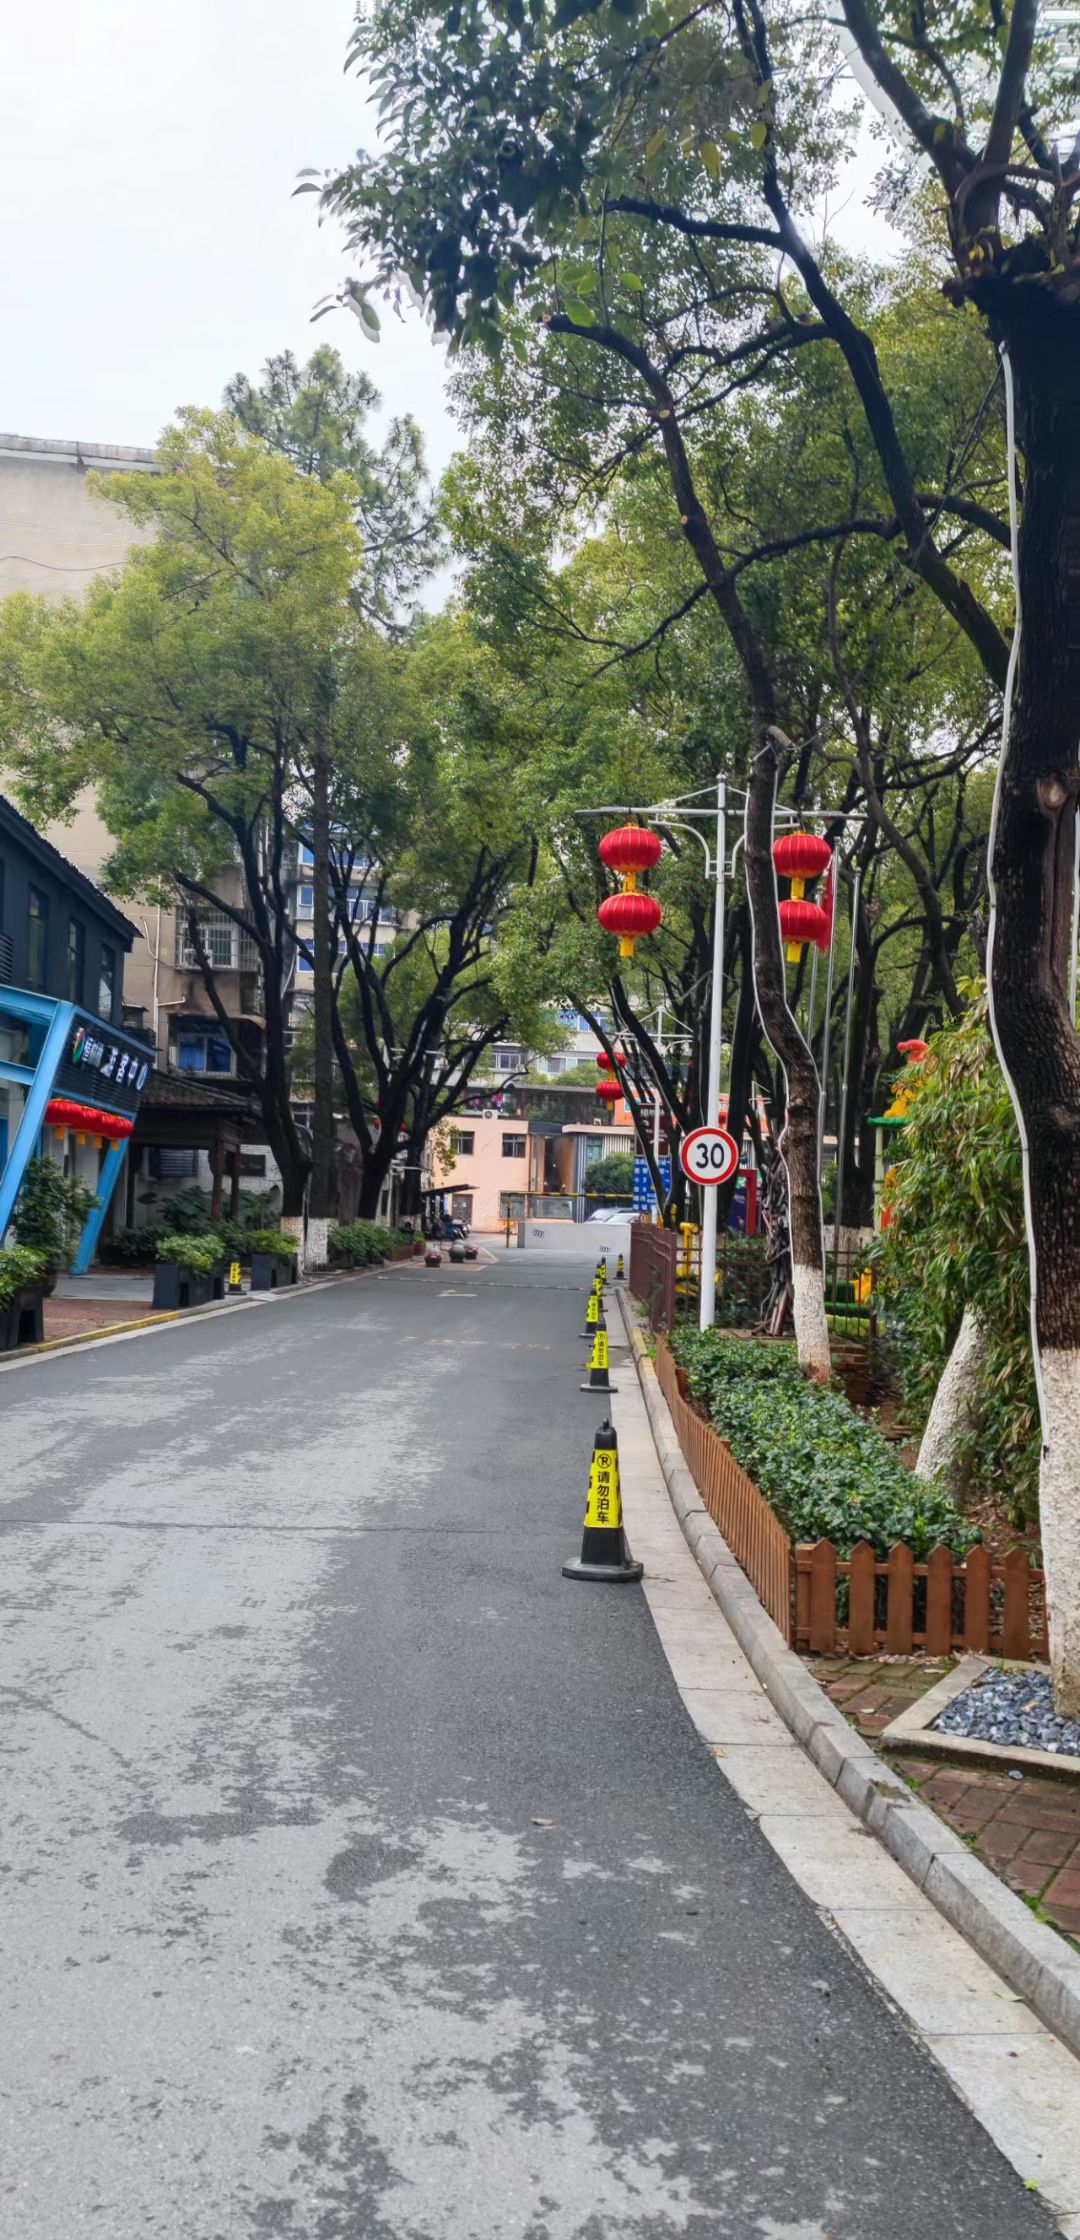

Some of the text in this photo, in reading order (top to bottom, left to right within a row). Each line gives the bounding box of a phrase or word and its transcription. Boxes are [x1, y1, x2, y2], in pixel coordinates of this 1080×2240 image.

[696, 1143, 725, 1169] 30
[596, 1471, 610, 1524] 请勿泊车
